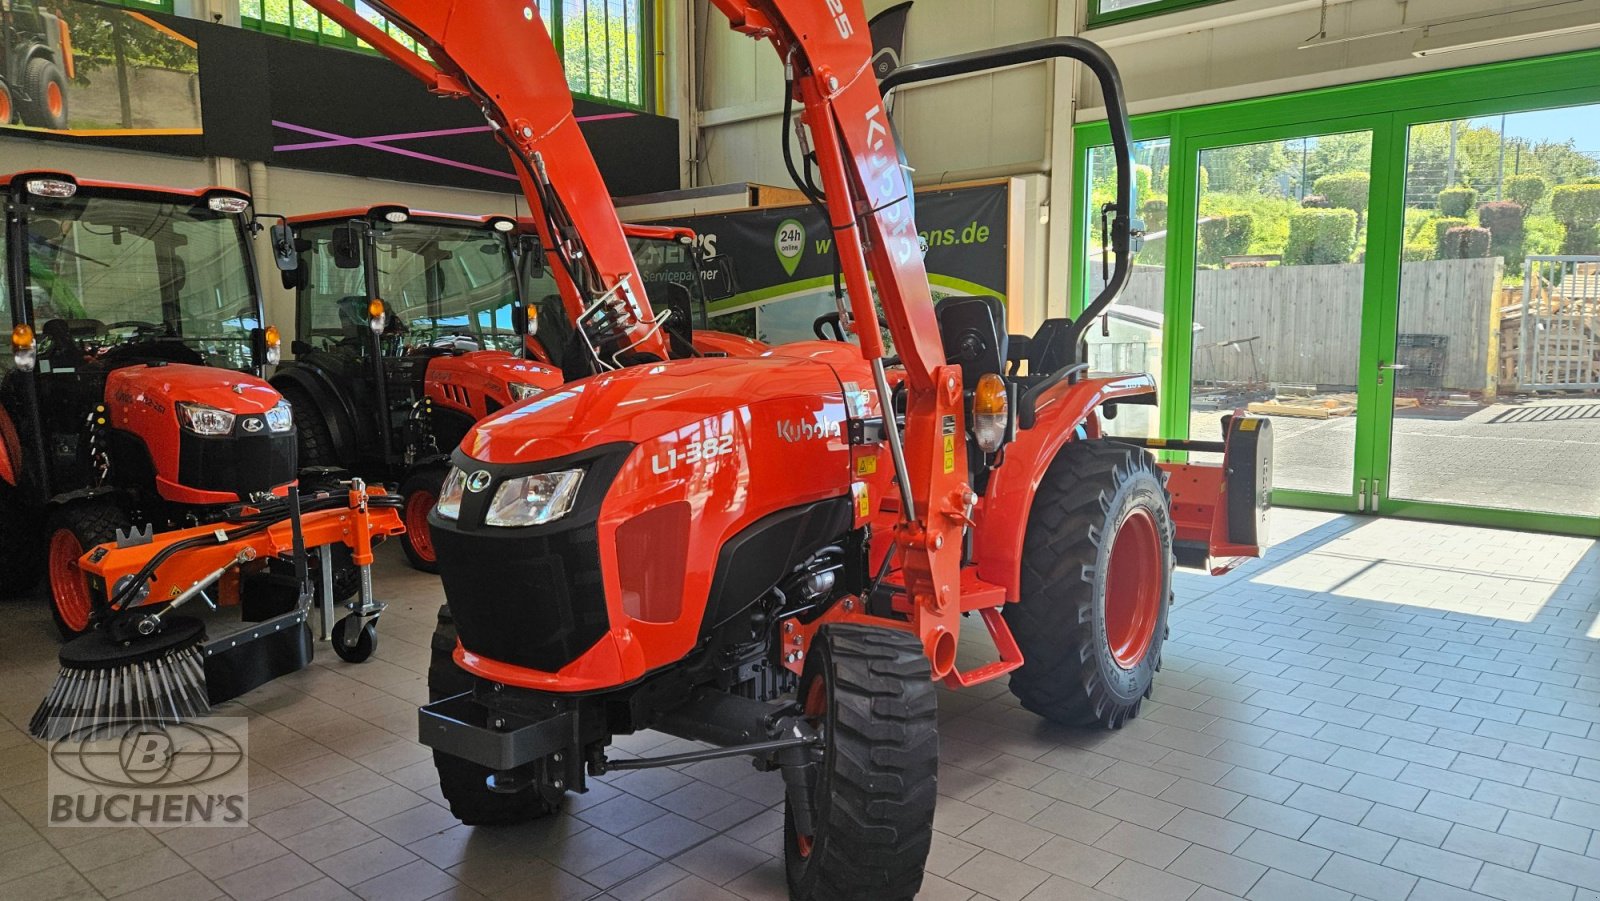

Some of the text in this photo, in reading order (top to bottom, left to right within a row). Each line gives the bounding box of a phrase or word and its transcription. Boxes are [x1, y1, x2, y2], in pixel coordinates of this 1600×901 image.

[780, 229, 801, 242] 24h
[781, 244, 799, 252] online
[776, 415, 841, 443] Kubota
[652, 434, 734, 475] L1-382
